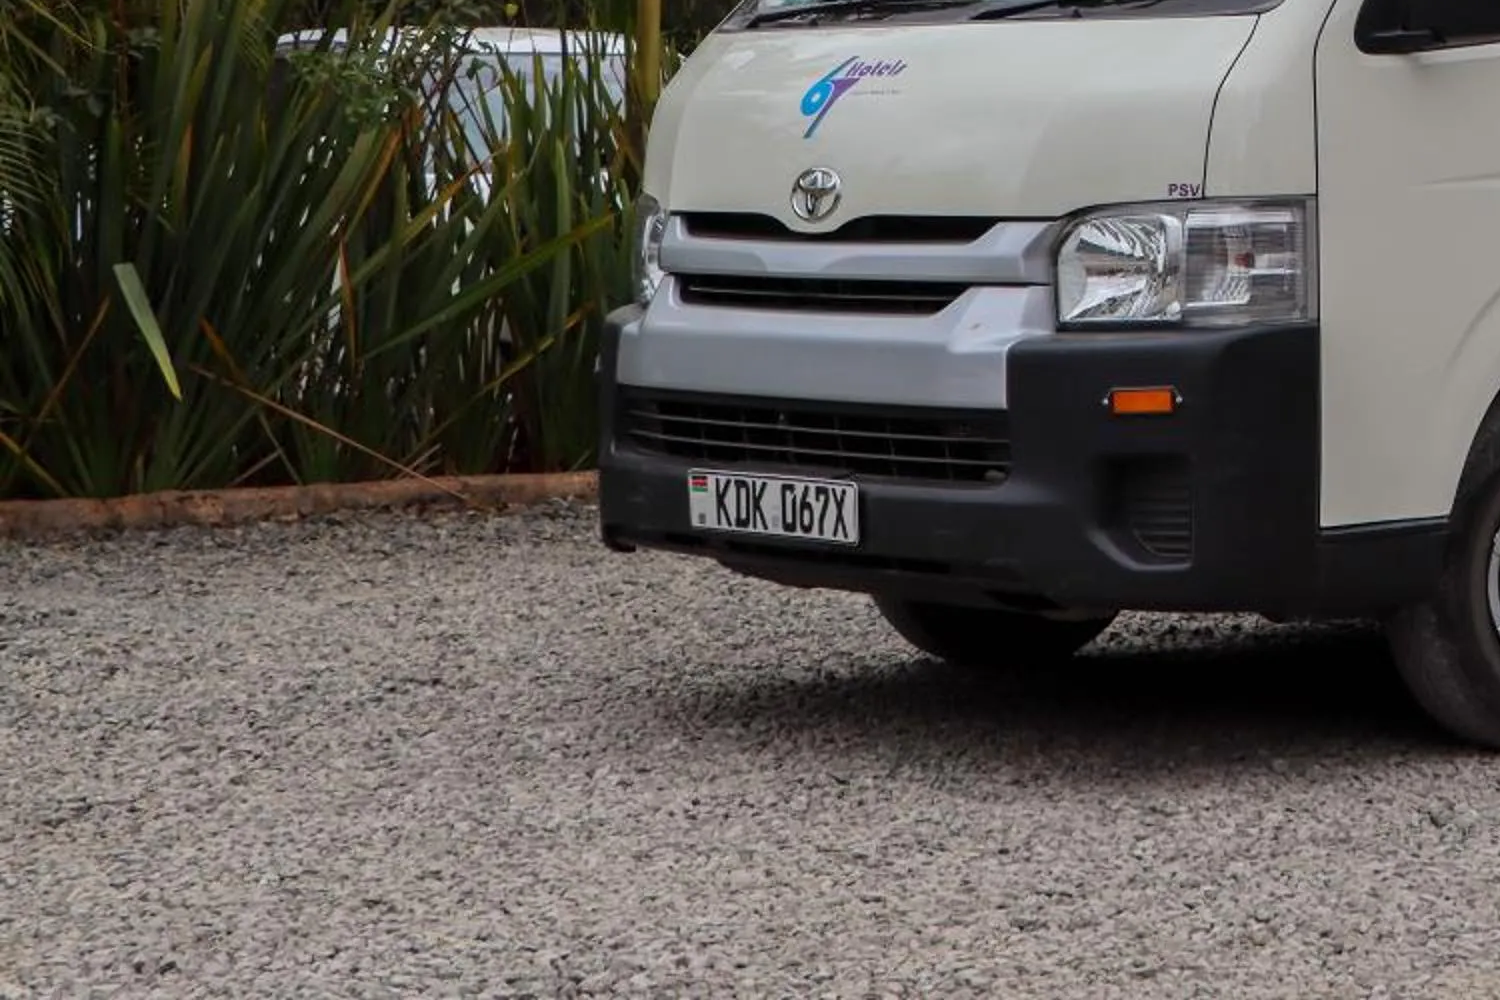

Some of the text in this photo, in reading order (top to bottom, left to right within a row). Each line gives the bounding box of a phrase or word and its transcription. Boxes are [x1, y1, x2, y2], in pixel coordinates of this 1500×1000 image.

[846, 60, 907, 77] Hotels
[1168, 183, 1200, 197] PSV
[715, 477, 848, 540] KDK 067X
